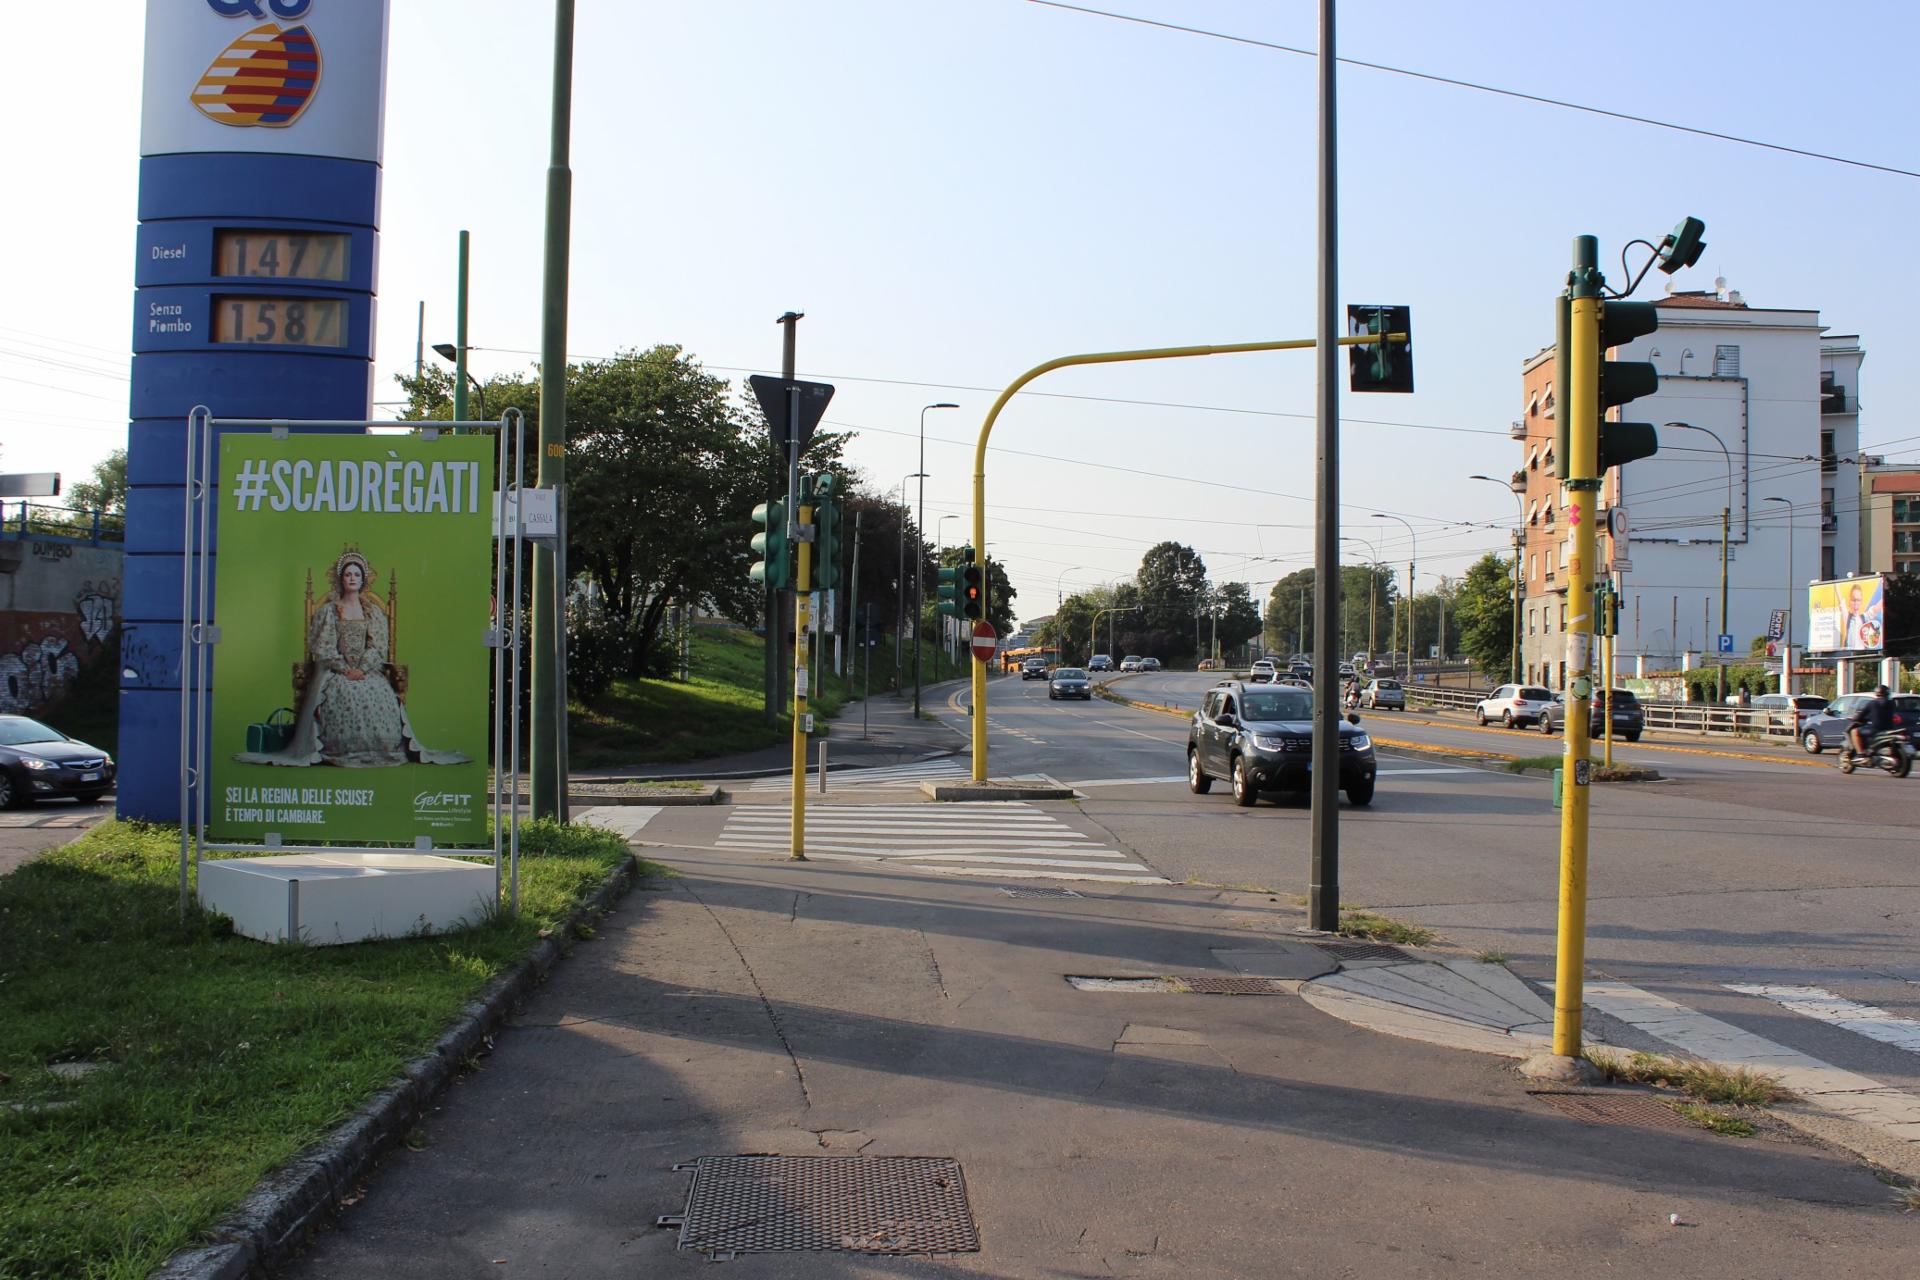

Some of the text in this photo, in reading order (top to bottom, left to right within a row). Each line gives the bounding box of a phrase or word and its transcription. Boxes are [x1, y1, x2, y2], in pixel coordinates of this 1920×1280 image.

[152, 244, 186, 259] Diesel
[150, 303, 182, 316] Senza
[149, 318, 192, 333] Piombo
[233, 450, 479, 513] #SCADRÈGATI
[1720, 636, 1730, 650] P
[225, 786, 374, 806] SEI LA REGINA DELLE SCUSE?
[225, 805, 326, 824] È TEMPO DI CAMBIARE.
